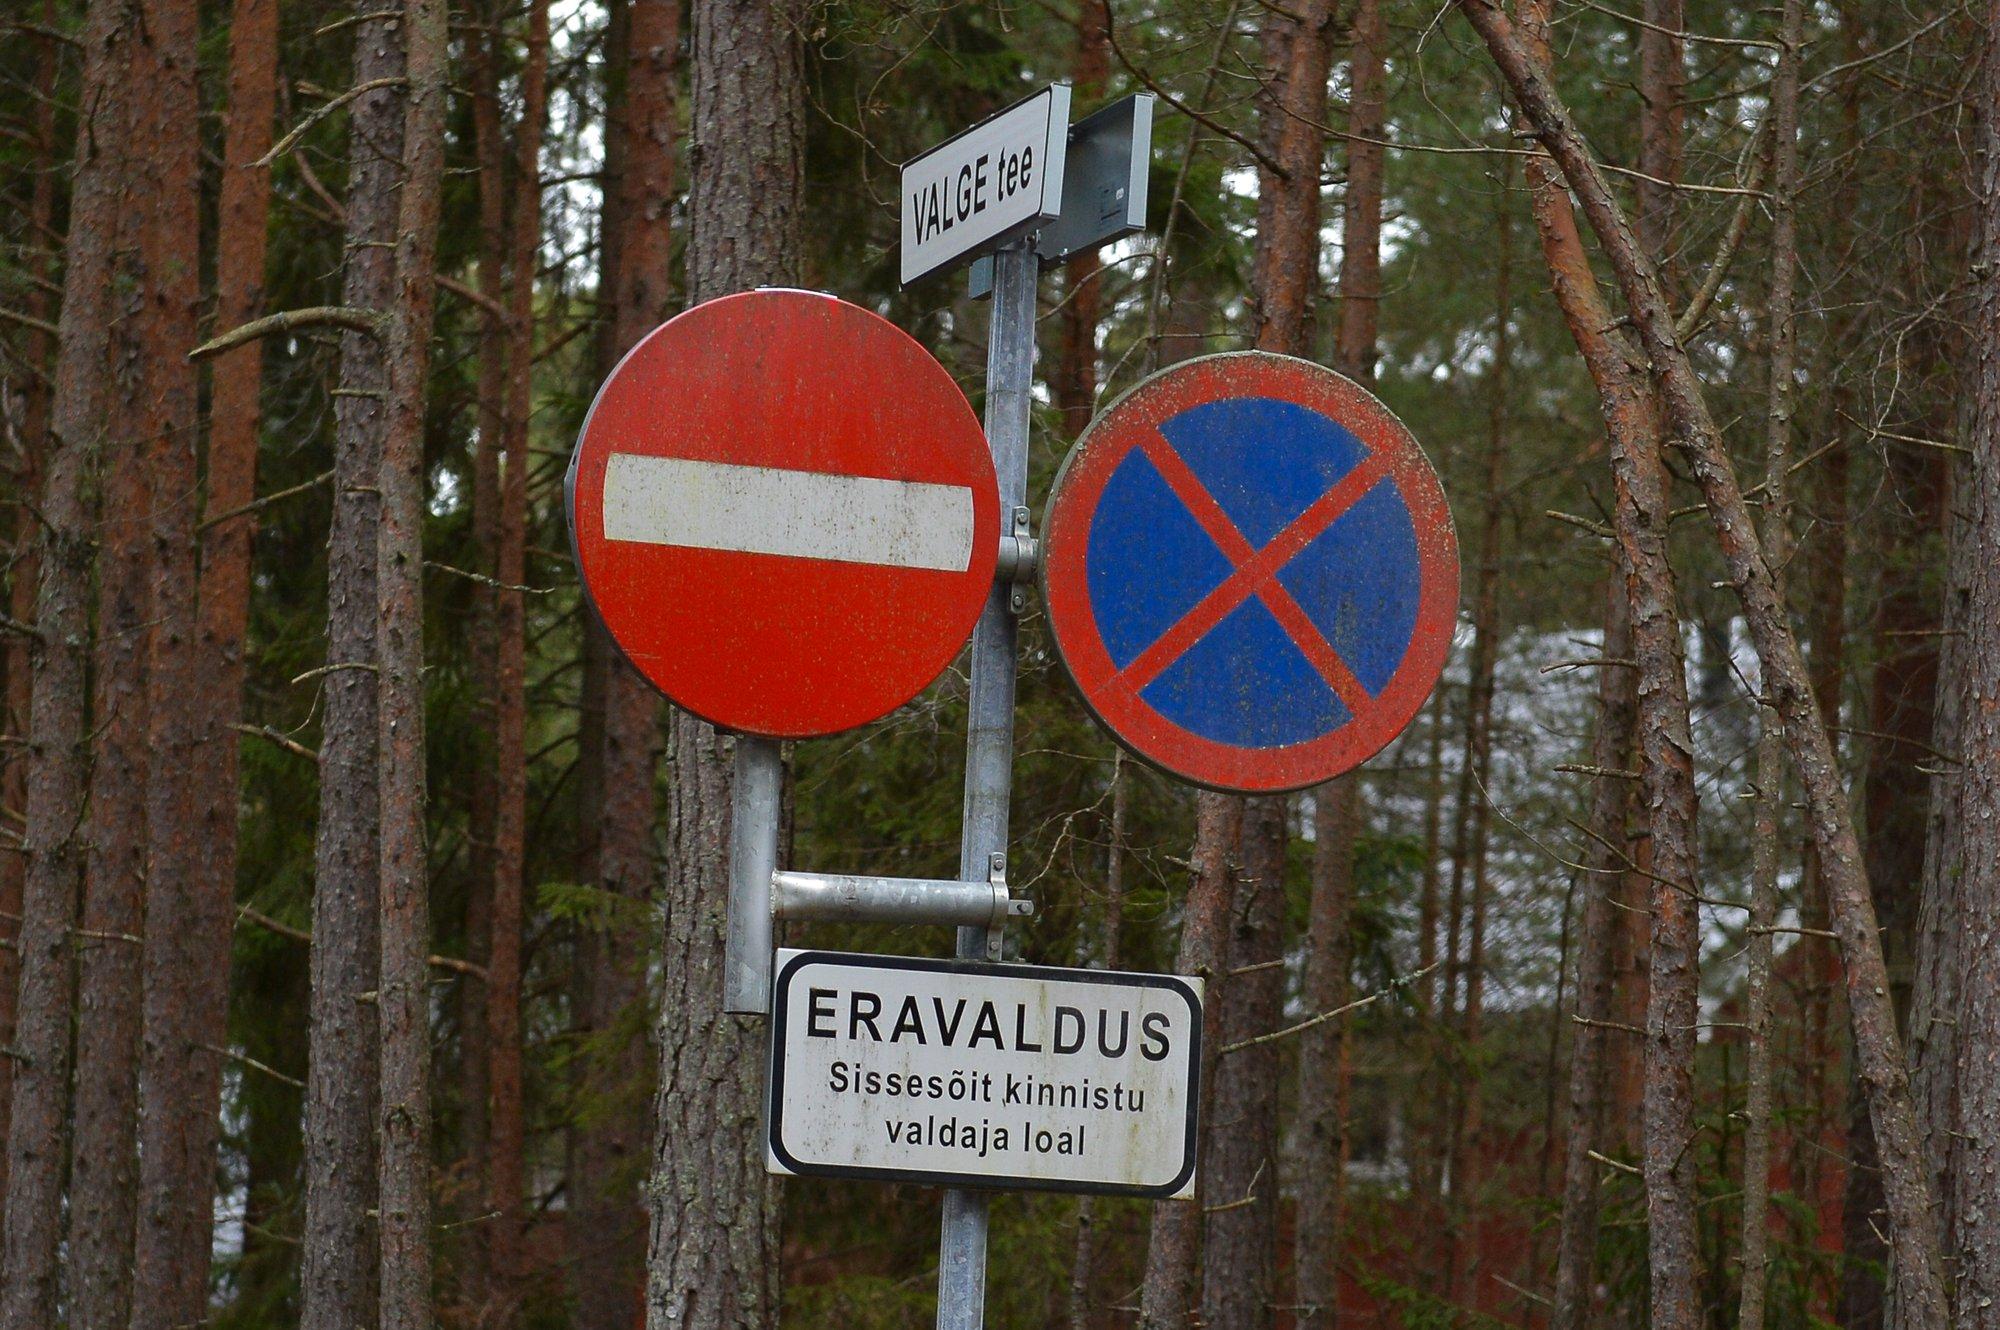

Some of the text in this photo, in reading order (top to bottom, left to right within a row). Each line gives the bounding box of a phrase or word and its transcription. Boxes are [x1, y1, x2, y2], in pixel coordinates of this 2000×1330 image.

[913, 145, 1032, 246] VALGE tee
[807, 987, 1171, 1061] ERAVALDUS
[829, 1061, 1145, 1112] Sissesõit kinnistu
[885, 1115, 1085, 1158] valdaja loal
